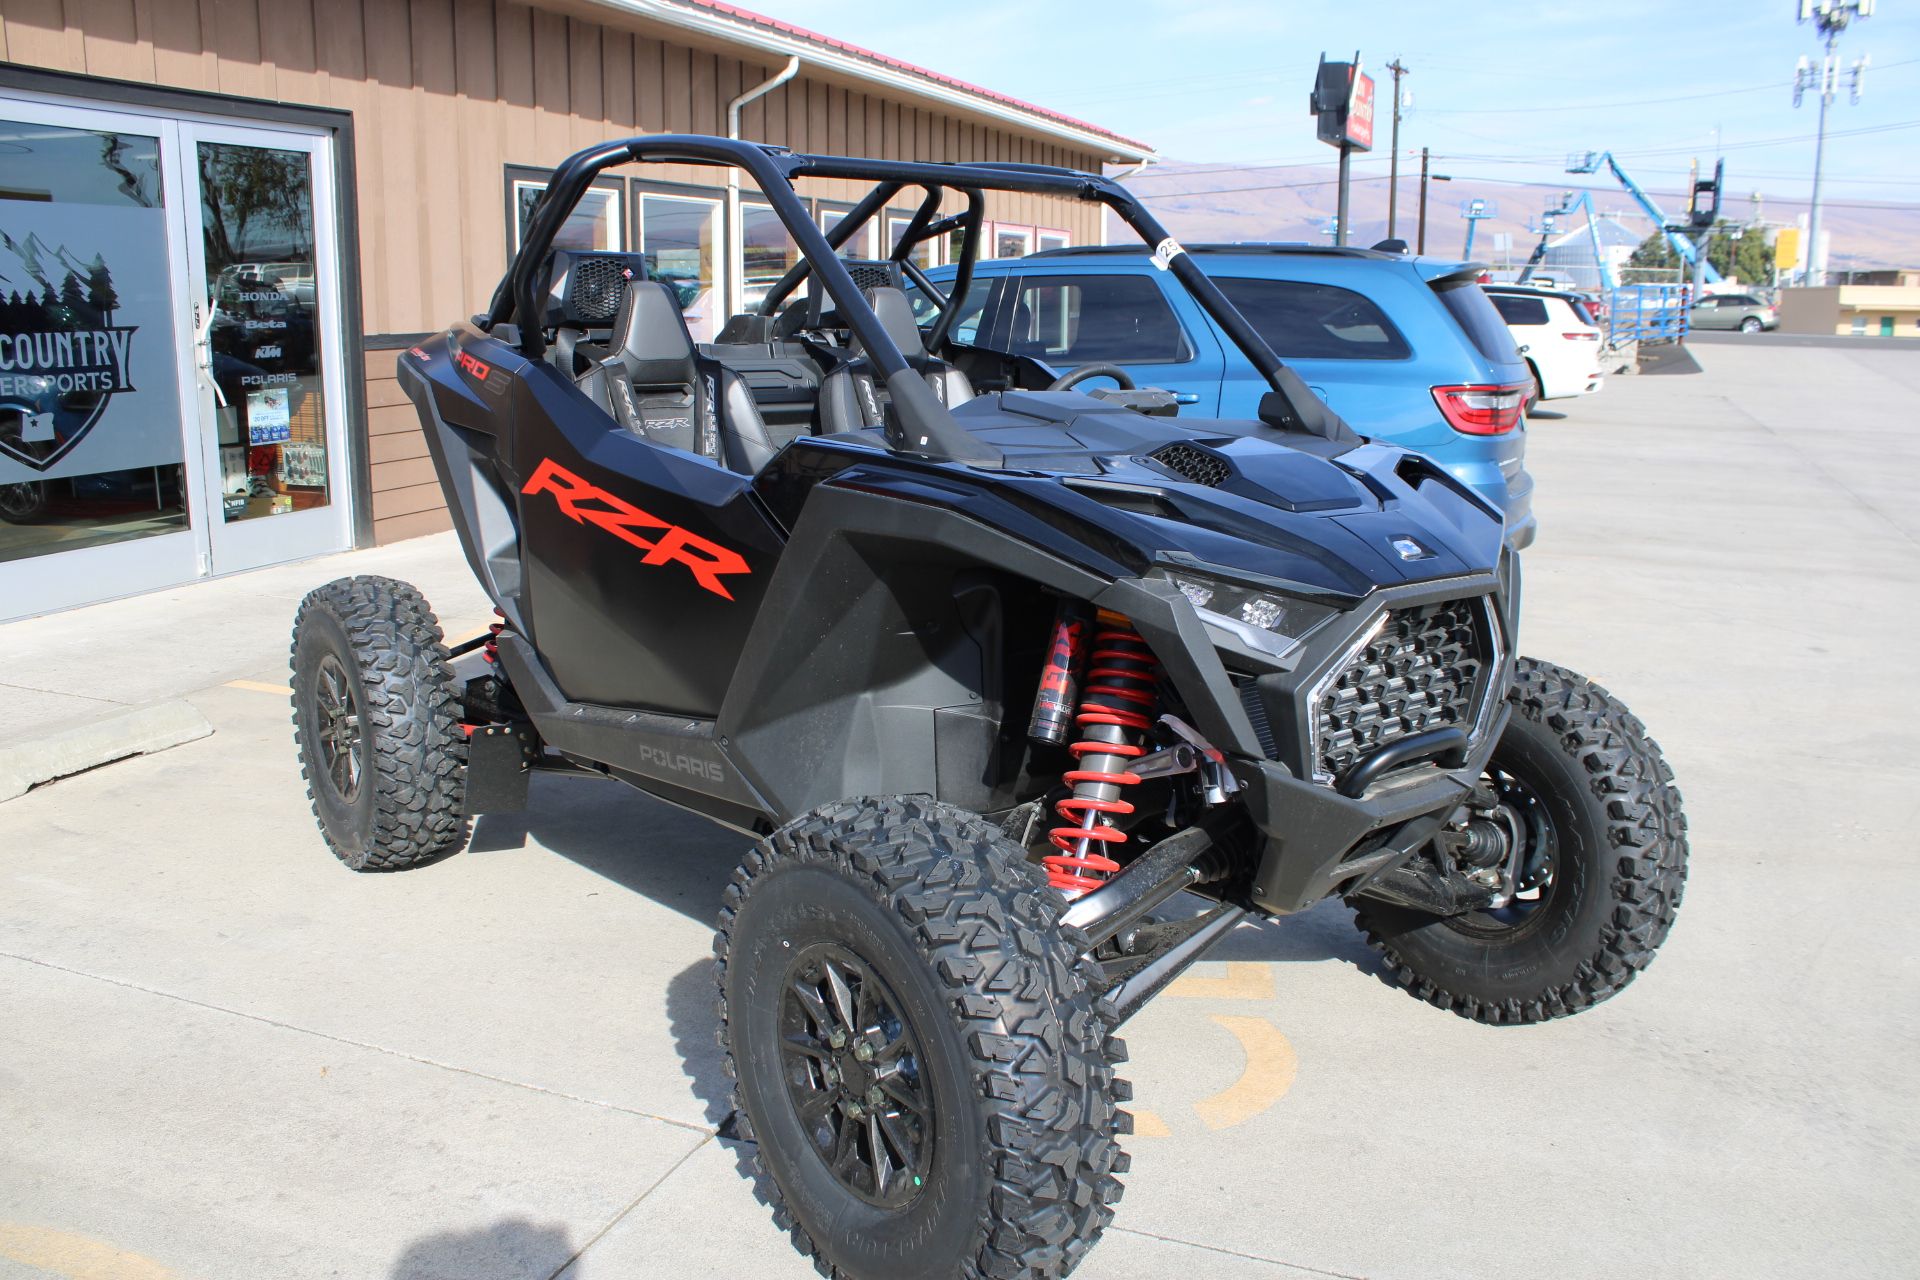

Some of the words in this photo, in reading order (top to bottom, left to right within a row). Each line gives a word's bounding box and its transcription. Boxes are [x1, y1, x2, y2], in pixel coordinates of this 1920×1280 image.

[239, 292, 289, 301] HONDA
[245, 320, 287, 329] Beta
[255, 345, 282, 359] KTM
[0, 330, 131, 389] COUNTRY
[241, 372, 297, 386] POLARIS
[644, 418, 691, 430] RZR
[521, 457, 752, 601] RZR
[639, 744, 725, 783] POLARIS
